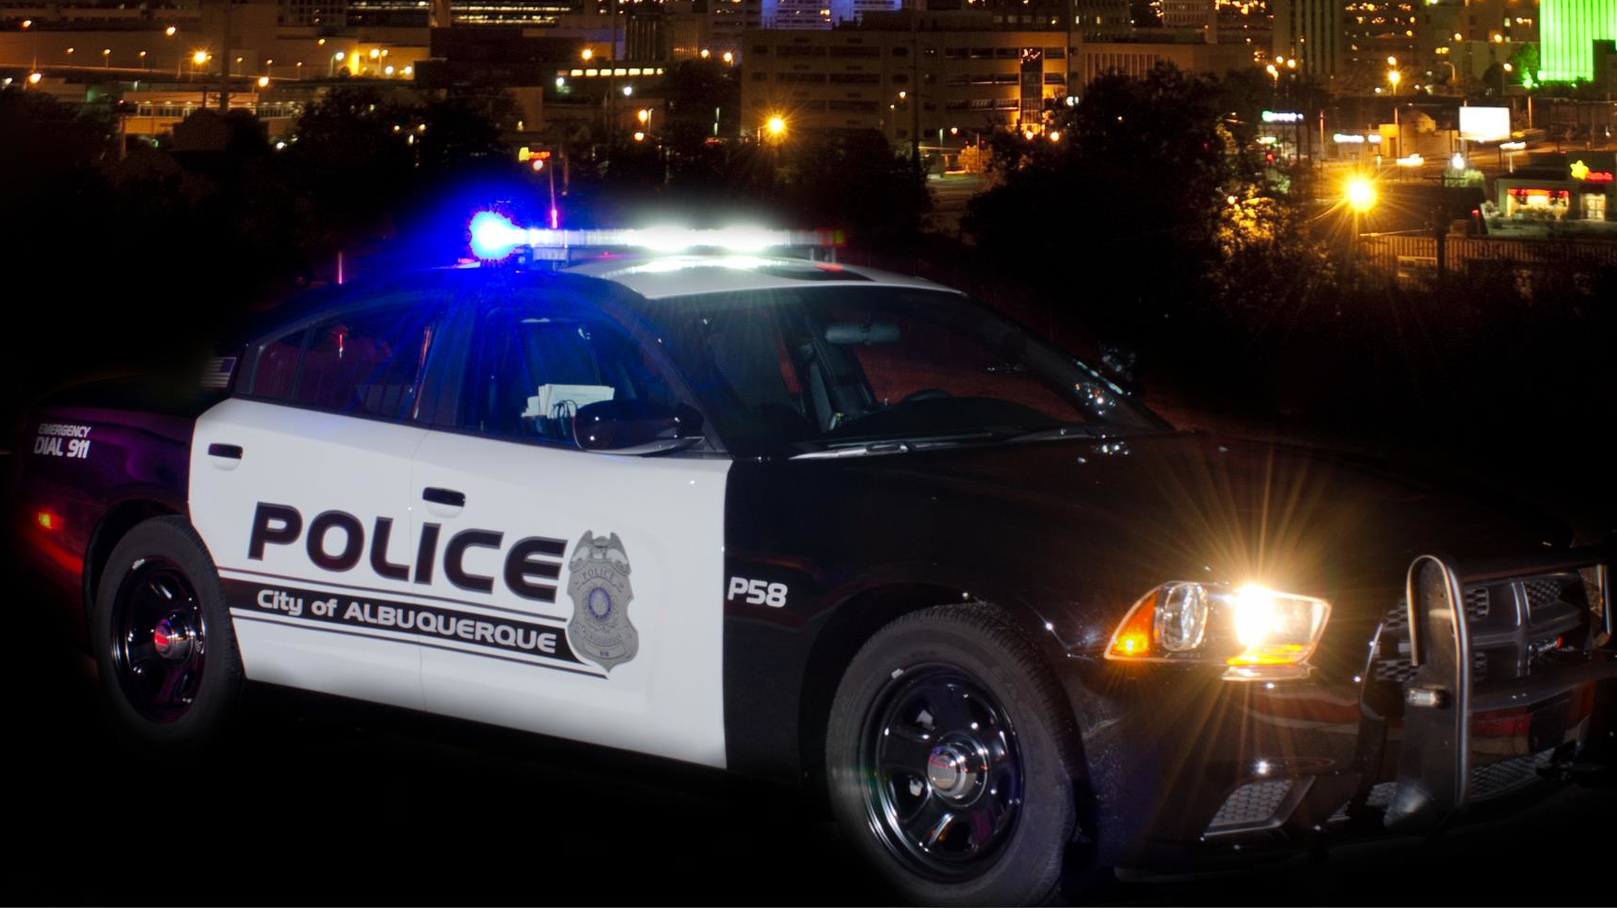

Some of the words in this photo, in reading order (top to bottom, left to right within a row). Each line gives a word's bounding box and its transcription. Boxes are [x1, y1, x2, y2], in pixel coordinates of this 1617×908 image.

[38, 423, 92, 438] EMERGENCY
[33, 436, 64, 456] DIAL
[66, 439, 91, 459] 911
[247, 500, 568, 604] POLICE
[727, 576, 788, 608] P58
[257, 589, 303, 616] City
[311, 599, 338, 616] of
[343, 600, 557, 655] ALBUQUERQUE
